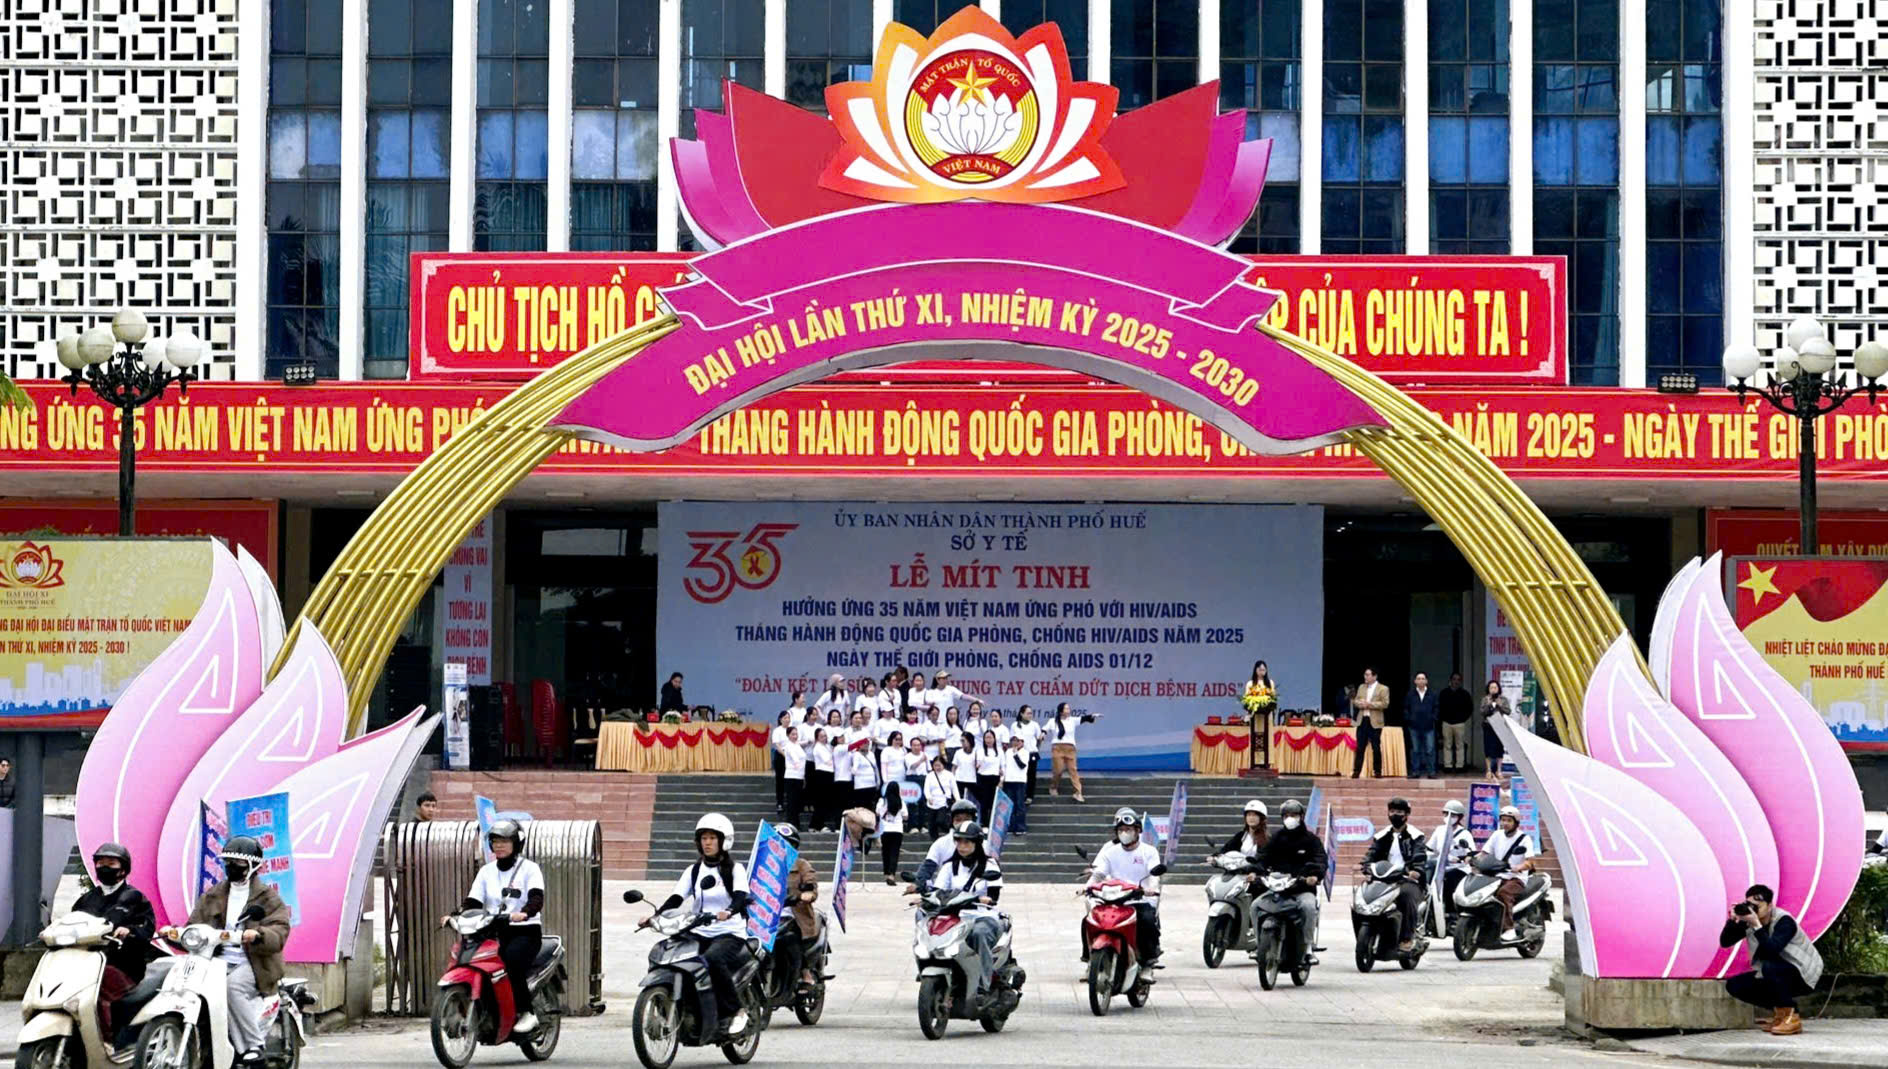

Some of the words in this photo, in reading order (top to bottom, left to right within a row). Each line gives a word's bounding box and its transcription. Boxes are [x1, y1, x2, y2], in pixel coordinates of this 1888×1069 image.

[943, 159, 971, 173] VIỆT
[974, 159, 1001, 173] NAM
[447, 270, 505, 353] CHỦ
[513, 285, 578, 363] TỊCH
[587, 266, 627, 349] HỒ
[1298, 272, 1357, 356] CỦA
[1365, 276, 1466, 356] CHÚNG
[1473, 289, 1511, 356] TA
[683, 347, 737, 395] ĐẠI
[735, 322, 787, 369] HỘI
[787, 299, 847, 349] LẦN
[850, 288, 907, 333] THỨ
[915, 292, 952, 327] XI,
[961, 288, 1054, 332] NHIỆM
[1060, 298, 1099, 337] KỲ
[1101, 312, 1174, 360] 2025
[1189, 349, 1260, 407] 2030
[47, 396, 104, 451] ỨNG
[112, 405, 145, 451] 35
[154, 397, 218, 451] NĂM
[227, 397, 285, 461] VIỆT
[293, 406, 357, 452] NAM
[366, 397, 423, 452] ỨNG
[798, 400, 874, 455] HÀNH
[882, 400, 960, 466] ĐỘNG
[969, 394, 1043, 461] QUỐC
[1053, 410, 1099, 456] GIA
[1108, 400, 1211, 462] PHÒNG,
[1453, 402, 1518, 457] NĂM
[1527, 412, 1595, 458] 2025
[1623, 404, 1700, 459] NGÀY
[1708, 399, 1762, 459] THẾ
[1769, 413, 1825, 460] GII
[834, 508, 858, 527] ỦY
[864, 514, 899, 528] BAN
[904, 512, 953, 528] NHÂN
[959, 512, 996, 528] DÂN
[1000, 512, 1062, 528] THÀNH
[1068, 508, 1105, 529] PHỐ
[1110, 509, 1147, 529] HUẾ
[951, 530, 976, 551] SỞ
[982, 535, 996, 551] Y
[1002, 528, 1028, 551] TẾ
[889, 552, 930, 588] LỄ
[941, 559, 1002, 588] MÍT
[1012, 565, 1091, 589] TINH
[782, 595, 837, 617] HƯỞNG
[841, 597, 875, 617] ỨNG
[879, 601, 899, 617] 35
[903, 598, 941, 617] NĂM
[945, 598, 979, 621] VIỆT
[983, 601, 1020, 618] NAM
[1025, 599, 1058, 618] ỨNG
[1063, 599, 1095, 618] PHÓ
[1099, 599, 1125, 618] VỚI
[1130, 602, 1198, 619] HIV/AIDS
[131, 613, 152, 633] QUỐC
[155, 616, 171, 635] VIỆT
[736, 623, 788, 642] THÁNG
[792, 623, 836, 642] HÀNH
[841, 623, 885, 645] ĐỘNG
[889, 621, 932, 644] QUỐC
[937, 626, 964, 643] GIA
[968, 623, 1027, 645] PHÒNG,
[1032, 621, 1086, 643] CHỐNG
[1091, 627, 1159, 644] HIV/AIDS
[1163, 625, 1201, 644] NĂM
[1205, 628, 1244, 644] 2025
[38, 637, 64, 656] NHIỆM
[79, 640, 98, 654] 2025
[105, 640, 125, 654] 2030
[826, 649, 870, 667] NGÀY
[874, 646, 903, 668] THẾ
[907, 649, 940, 668] GIỚI
[944, 650, 1003, 670] PHÒNG,
[1008, 647, 1062, 669] CHỐNG
[1067, 653, 1104, 669] AIDS
[1109, 653, 1153, 669] 01/12
[1765, 638, 1793, 658] NHIỆT
[1795, 638, 1815, 658] LIỆT
[1818, 638, 1843, 655] CHÀO
[1846, 638, 1876, 656] MỪNG
[1810, 661, 1842, 678] THÀNH
[1844, 660, 1864, 679] PHỐ
[1866, 660, 1886, 679] HUẾ
[787, 671, 818, 693] KẾT
[953, 680, 991, 695] HUNG
[997, 680, 1025, 696] TAY
[1030, 675, 1074, 696] CHẤM
[1078, 677, 1110, 696] DỨT
[1114, 681, 1151, 700] DỊCH
[1156, 679, 1197, 700] BỆNH
